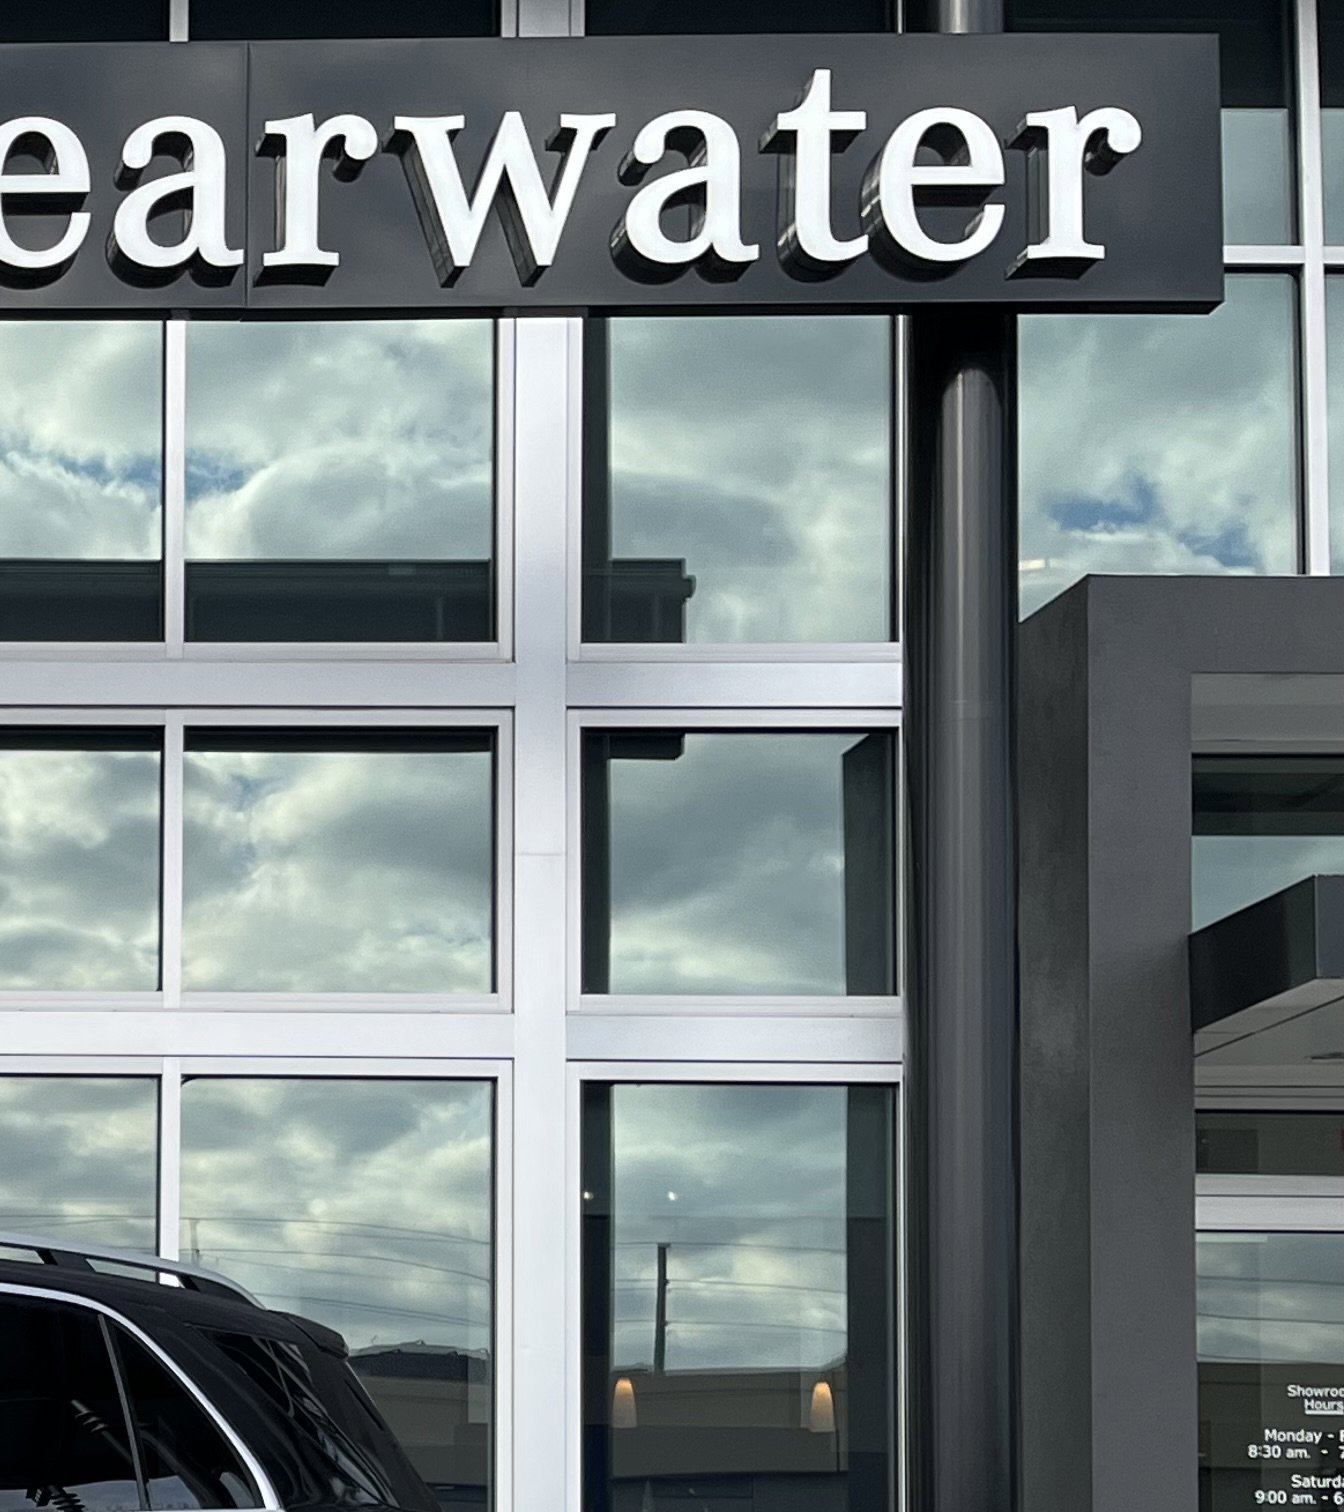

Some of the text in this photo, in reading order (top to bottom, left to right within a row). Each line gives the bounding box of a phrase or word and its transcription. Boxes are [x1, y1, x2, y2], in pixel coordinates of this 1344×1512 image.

[1264, 1429, 1323, 1445] Monday
[1248, 1444, 1282, 1459] 8:30
[1285, 1448, 1311, 1459] am.
[1254, 1490, 1287, 1504] 9:00
[1291, 1493, 1317, 1505] am.
